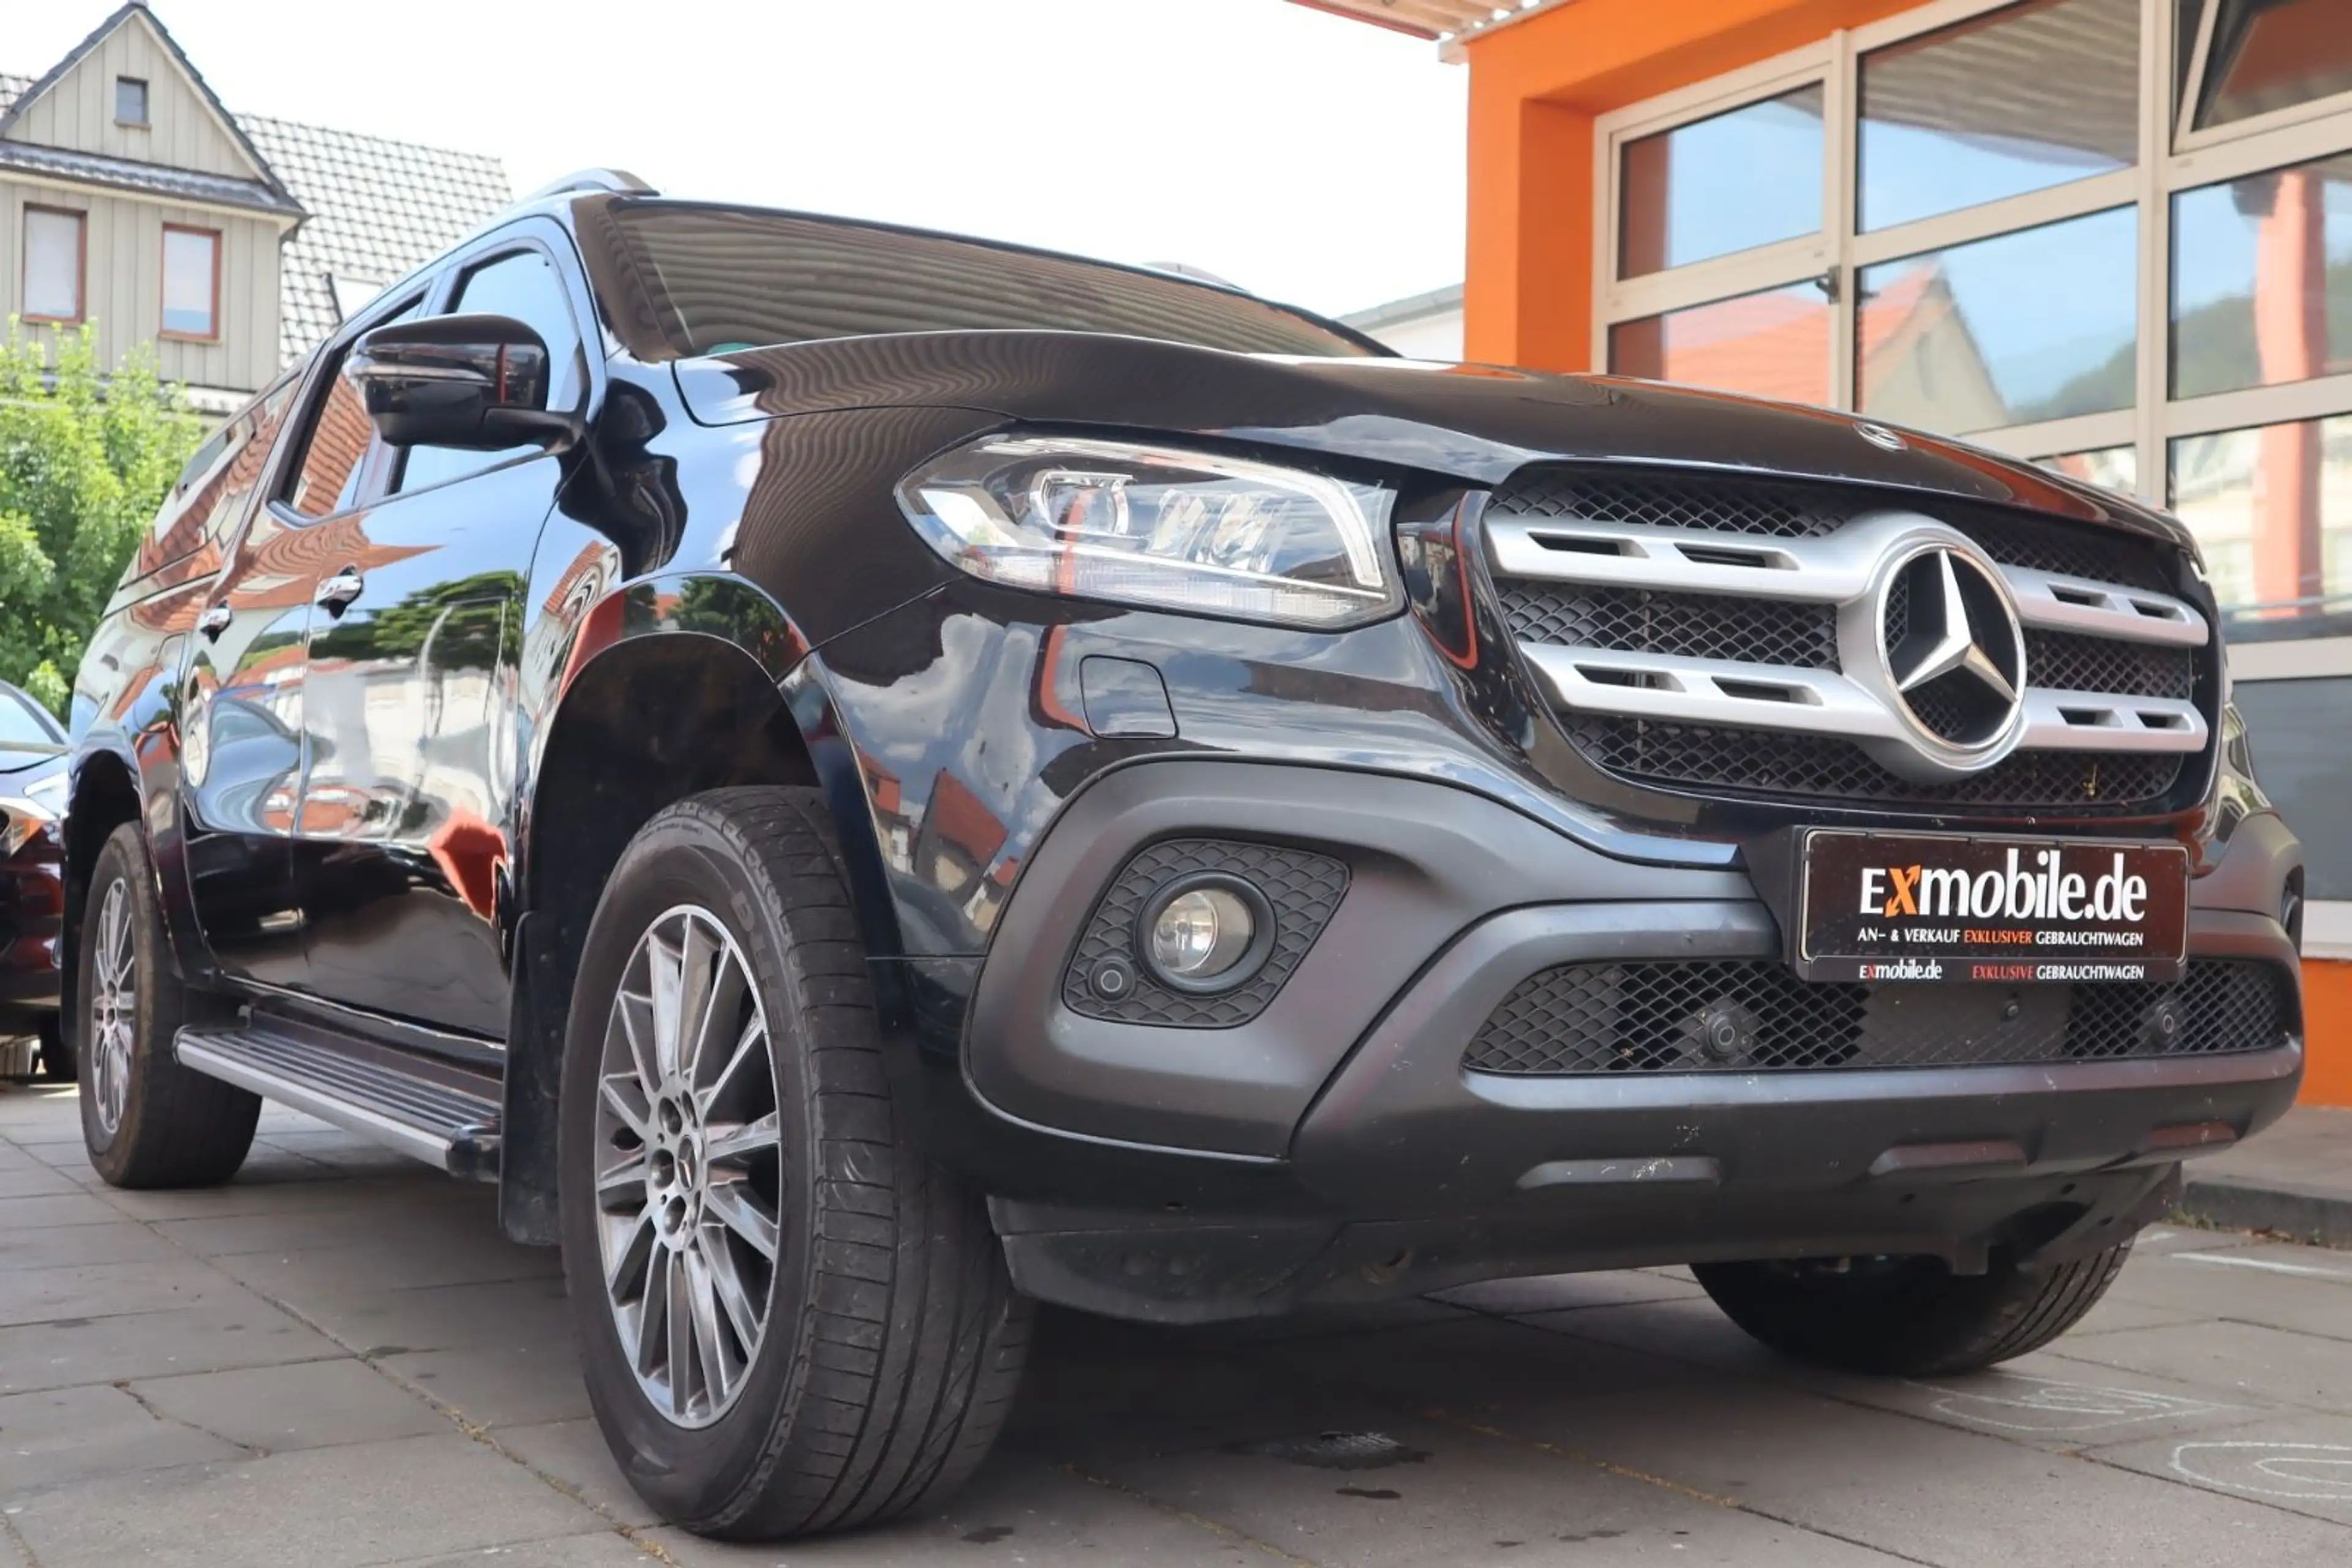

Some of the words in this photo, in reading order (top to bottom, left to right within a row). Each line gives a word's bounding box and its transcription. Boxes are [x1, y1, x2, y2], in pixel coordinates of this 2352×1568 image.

[1858, 927, 1886, 942] AN-
[1891, 929, 1899, 942] &
[1904, 928, 1961, 943] VERKAUF
[1964, 929, 2032, 944] EXKLUSIVER
[2035, 930, 2143, 946] GEBRAUCHTWAGEN
[1972, 965, 2034, 979] EXKLUSIVE
[2036, 965, 2144, 980] GEBRAUCHTWAGEN
